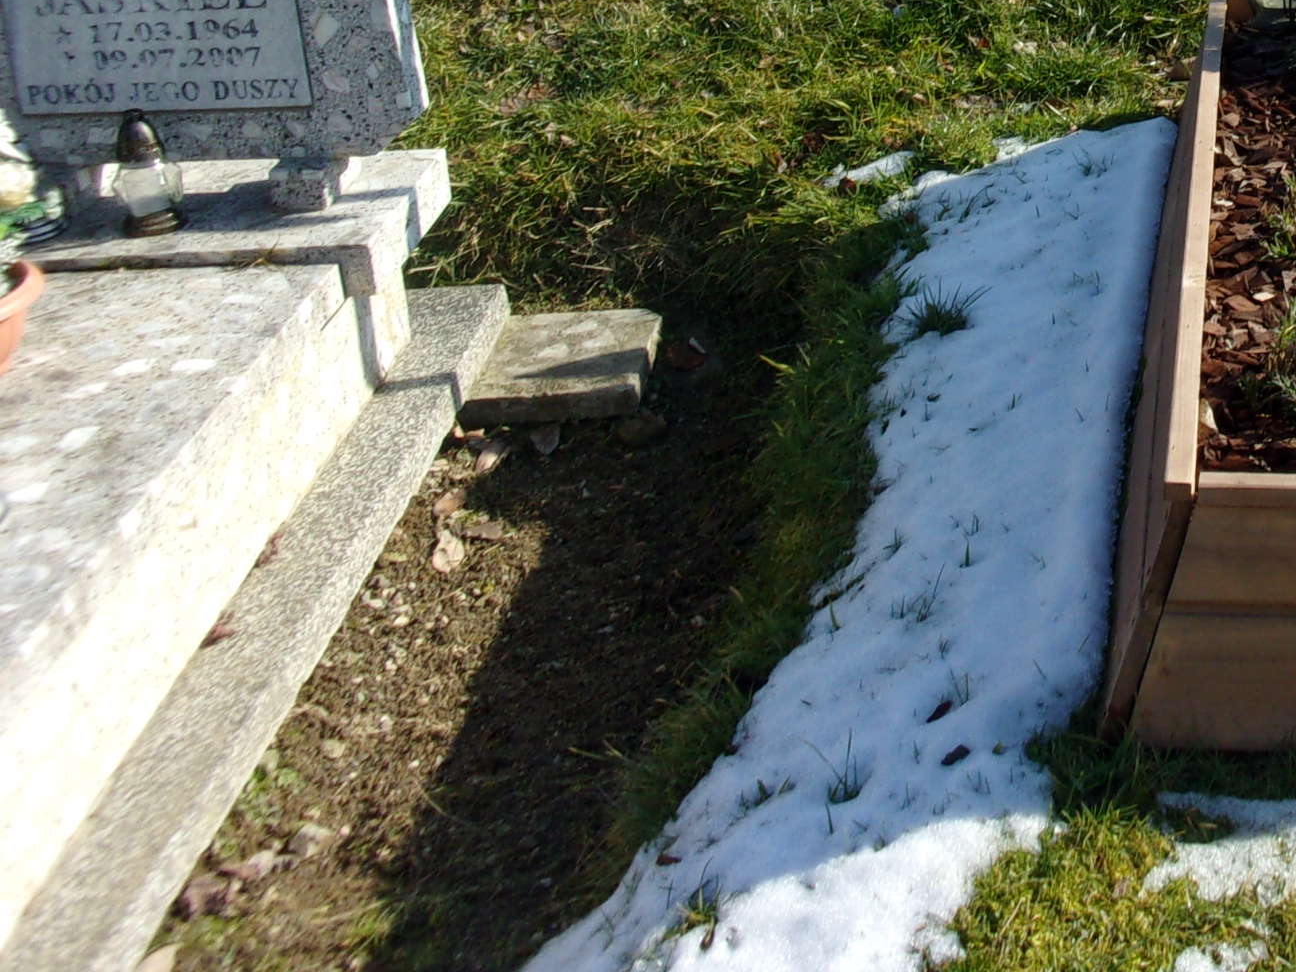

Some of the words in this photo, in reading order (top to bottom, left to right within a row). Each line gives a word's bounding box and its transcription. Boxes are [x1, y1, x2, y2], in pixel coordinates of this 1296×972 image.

[88, 18, 260, 44] 17.03.1964
[93, 46, 262, 70] 09.07.2007
[27, 79, 116, 105] POKÓJ
[129, 81, 200, 102] JEGO
[213, 78, 299, 101] DUSZY
